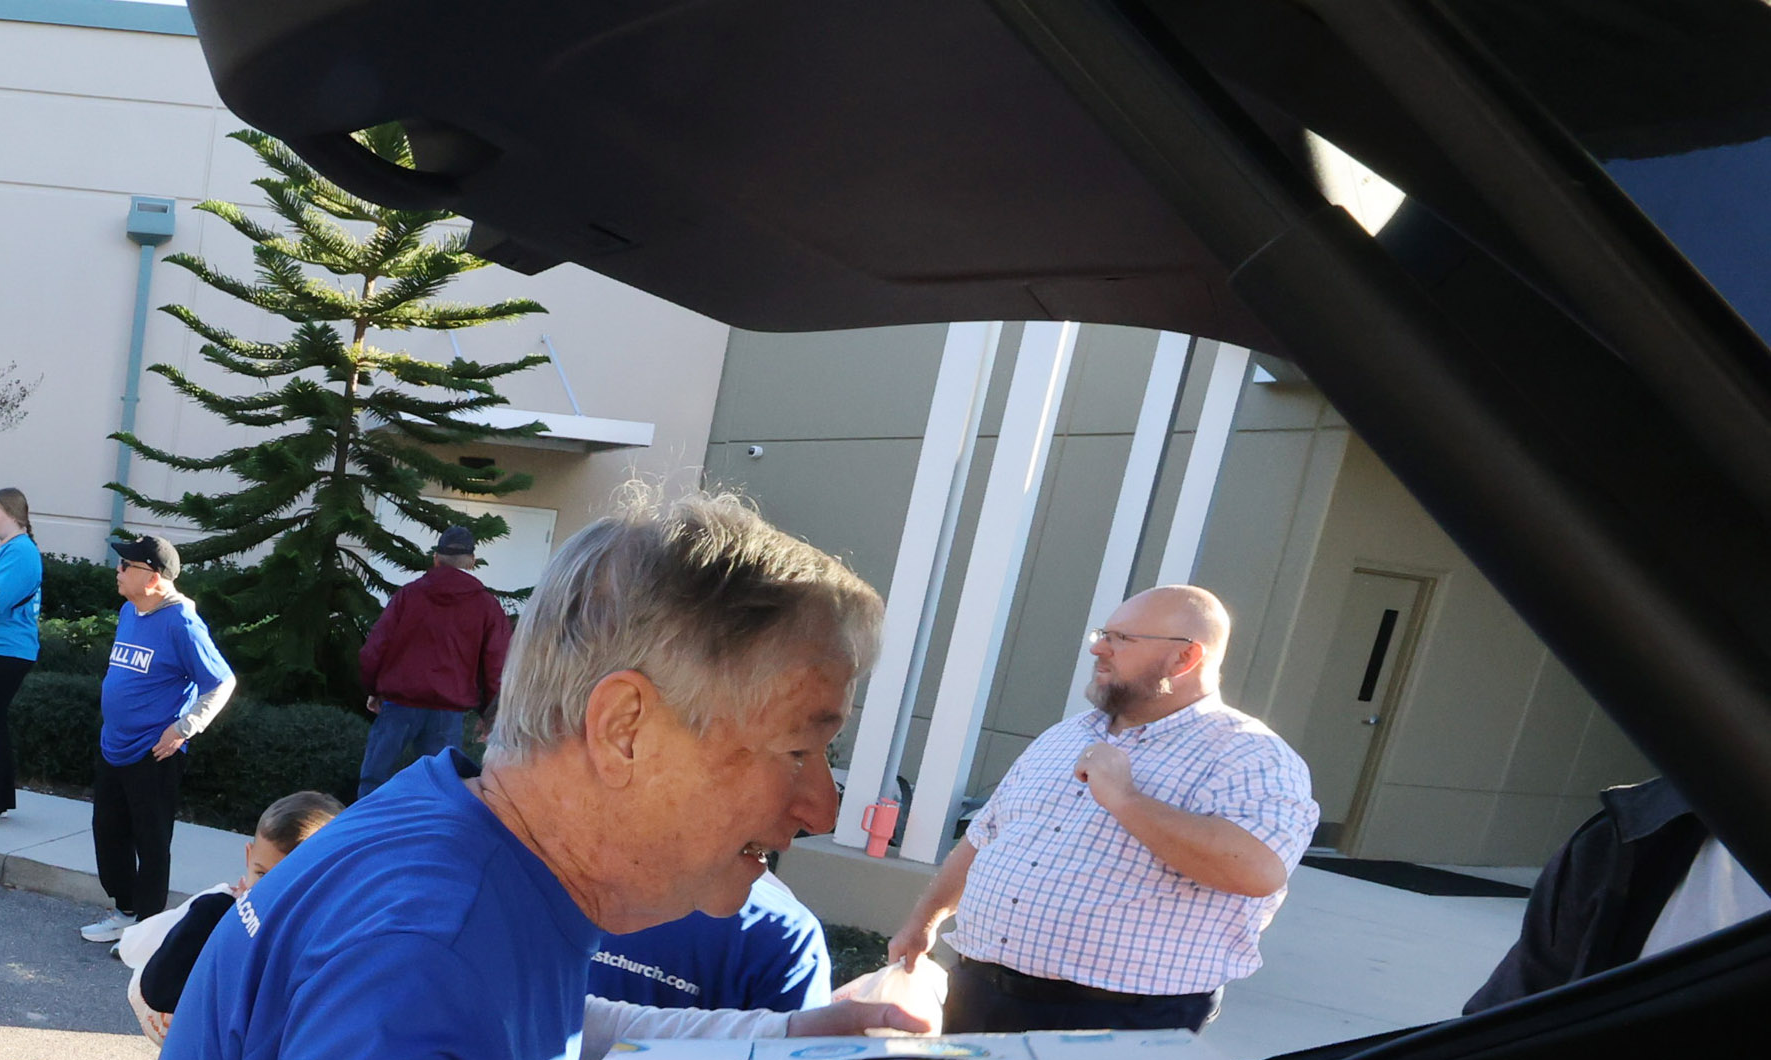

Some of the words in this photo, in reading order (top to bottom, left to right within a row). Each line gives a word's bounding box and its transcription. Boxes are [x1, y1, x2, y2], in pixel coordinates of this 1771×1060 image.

[110, 646, 130, 664] ALL
[130, 650, 150, 668] IN
[591, 951, 700, 996] stchurch.com
